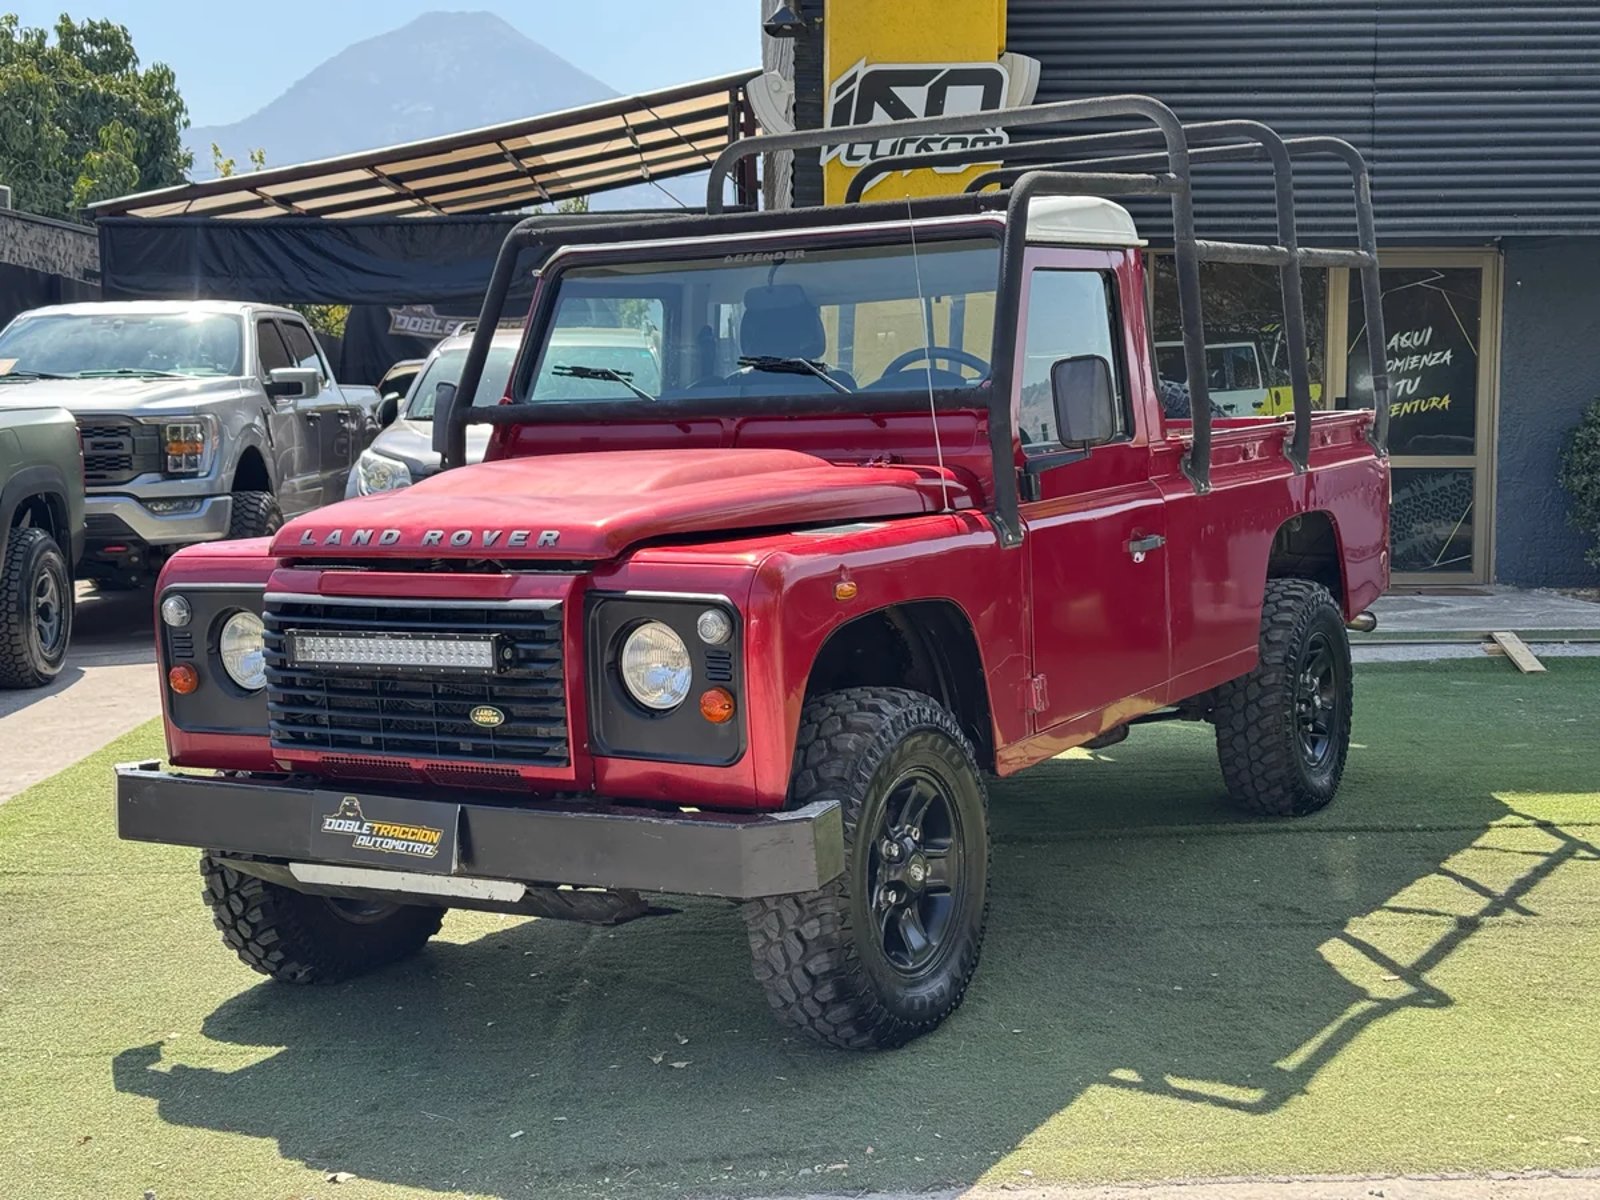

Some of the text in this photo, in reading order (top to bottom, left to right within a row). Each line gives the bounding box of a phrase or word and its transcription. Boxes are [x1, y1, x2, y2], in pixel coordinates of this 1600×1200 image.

[724, 250, 805, 263] DEFENDER
[1387, 326, 1432, 352] AQUI
[1386, 348, 1453, 374] OMIENZA
[1395, 376, 1421, 398] TU
[1389, 394, 1450, 417] ENTURA
[300, 529, 560, 547] LAND ROVER
[356, 835, 434, 855] AUTOMOTRIZ
